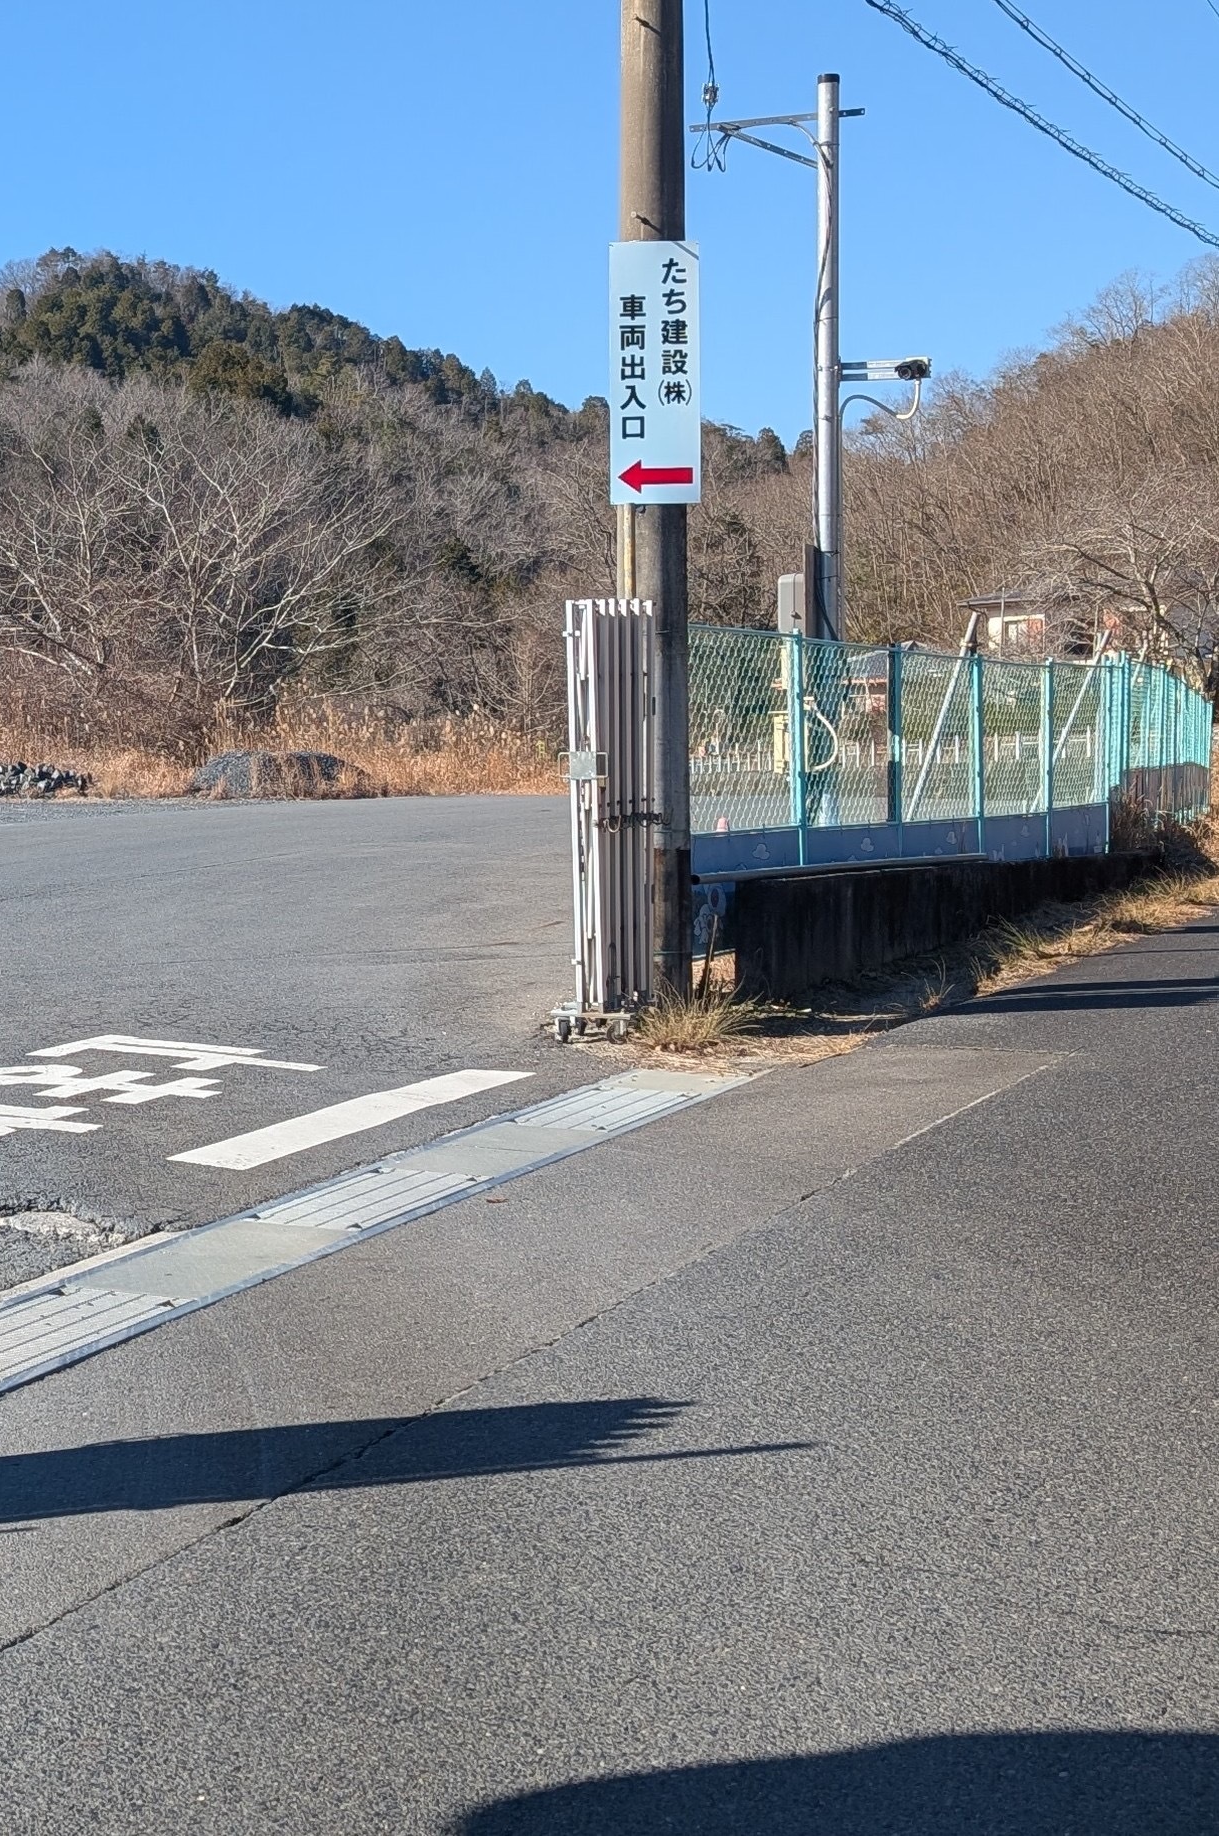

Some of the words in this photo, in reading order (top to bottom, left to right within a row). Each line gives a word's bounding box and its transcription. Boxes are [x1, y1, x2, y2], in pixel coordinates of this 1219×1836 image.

[619, 294, 647, 440] 車両出入口
[657, 257, 692, 406] たち建設(株)
